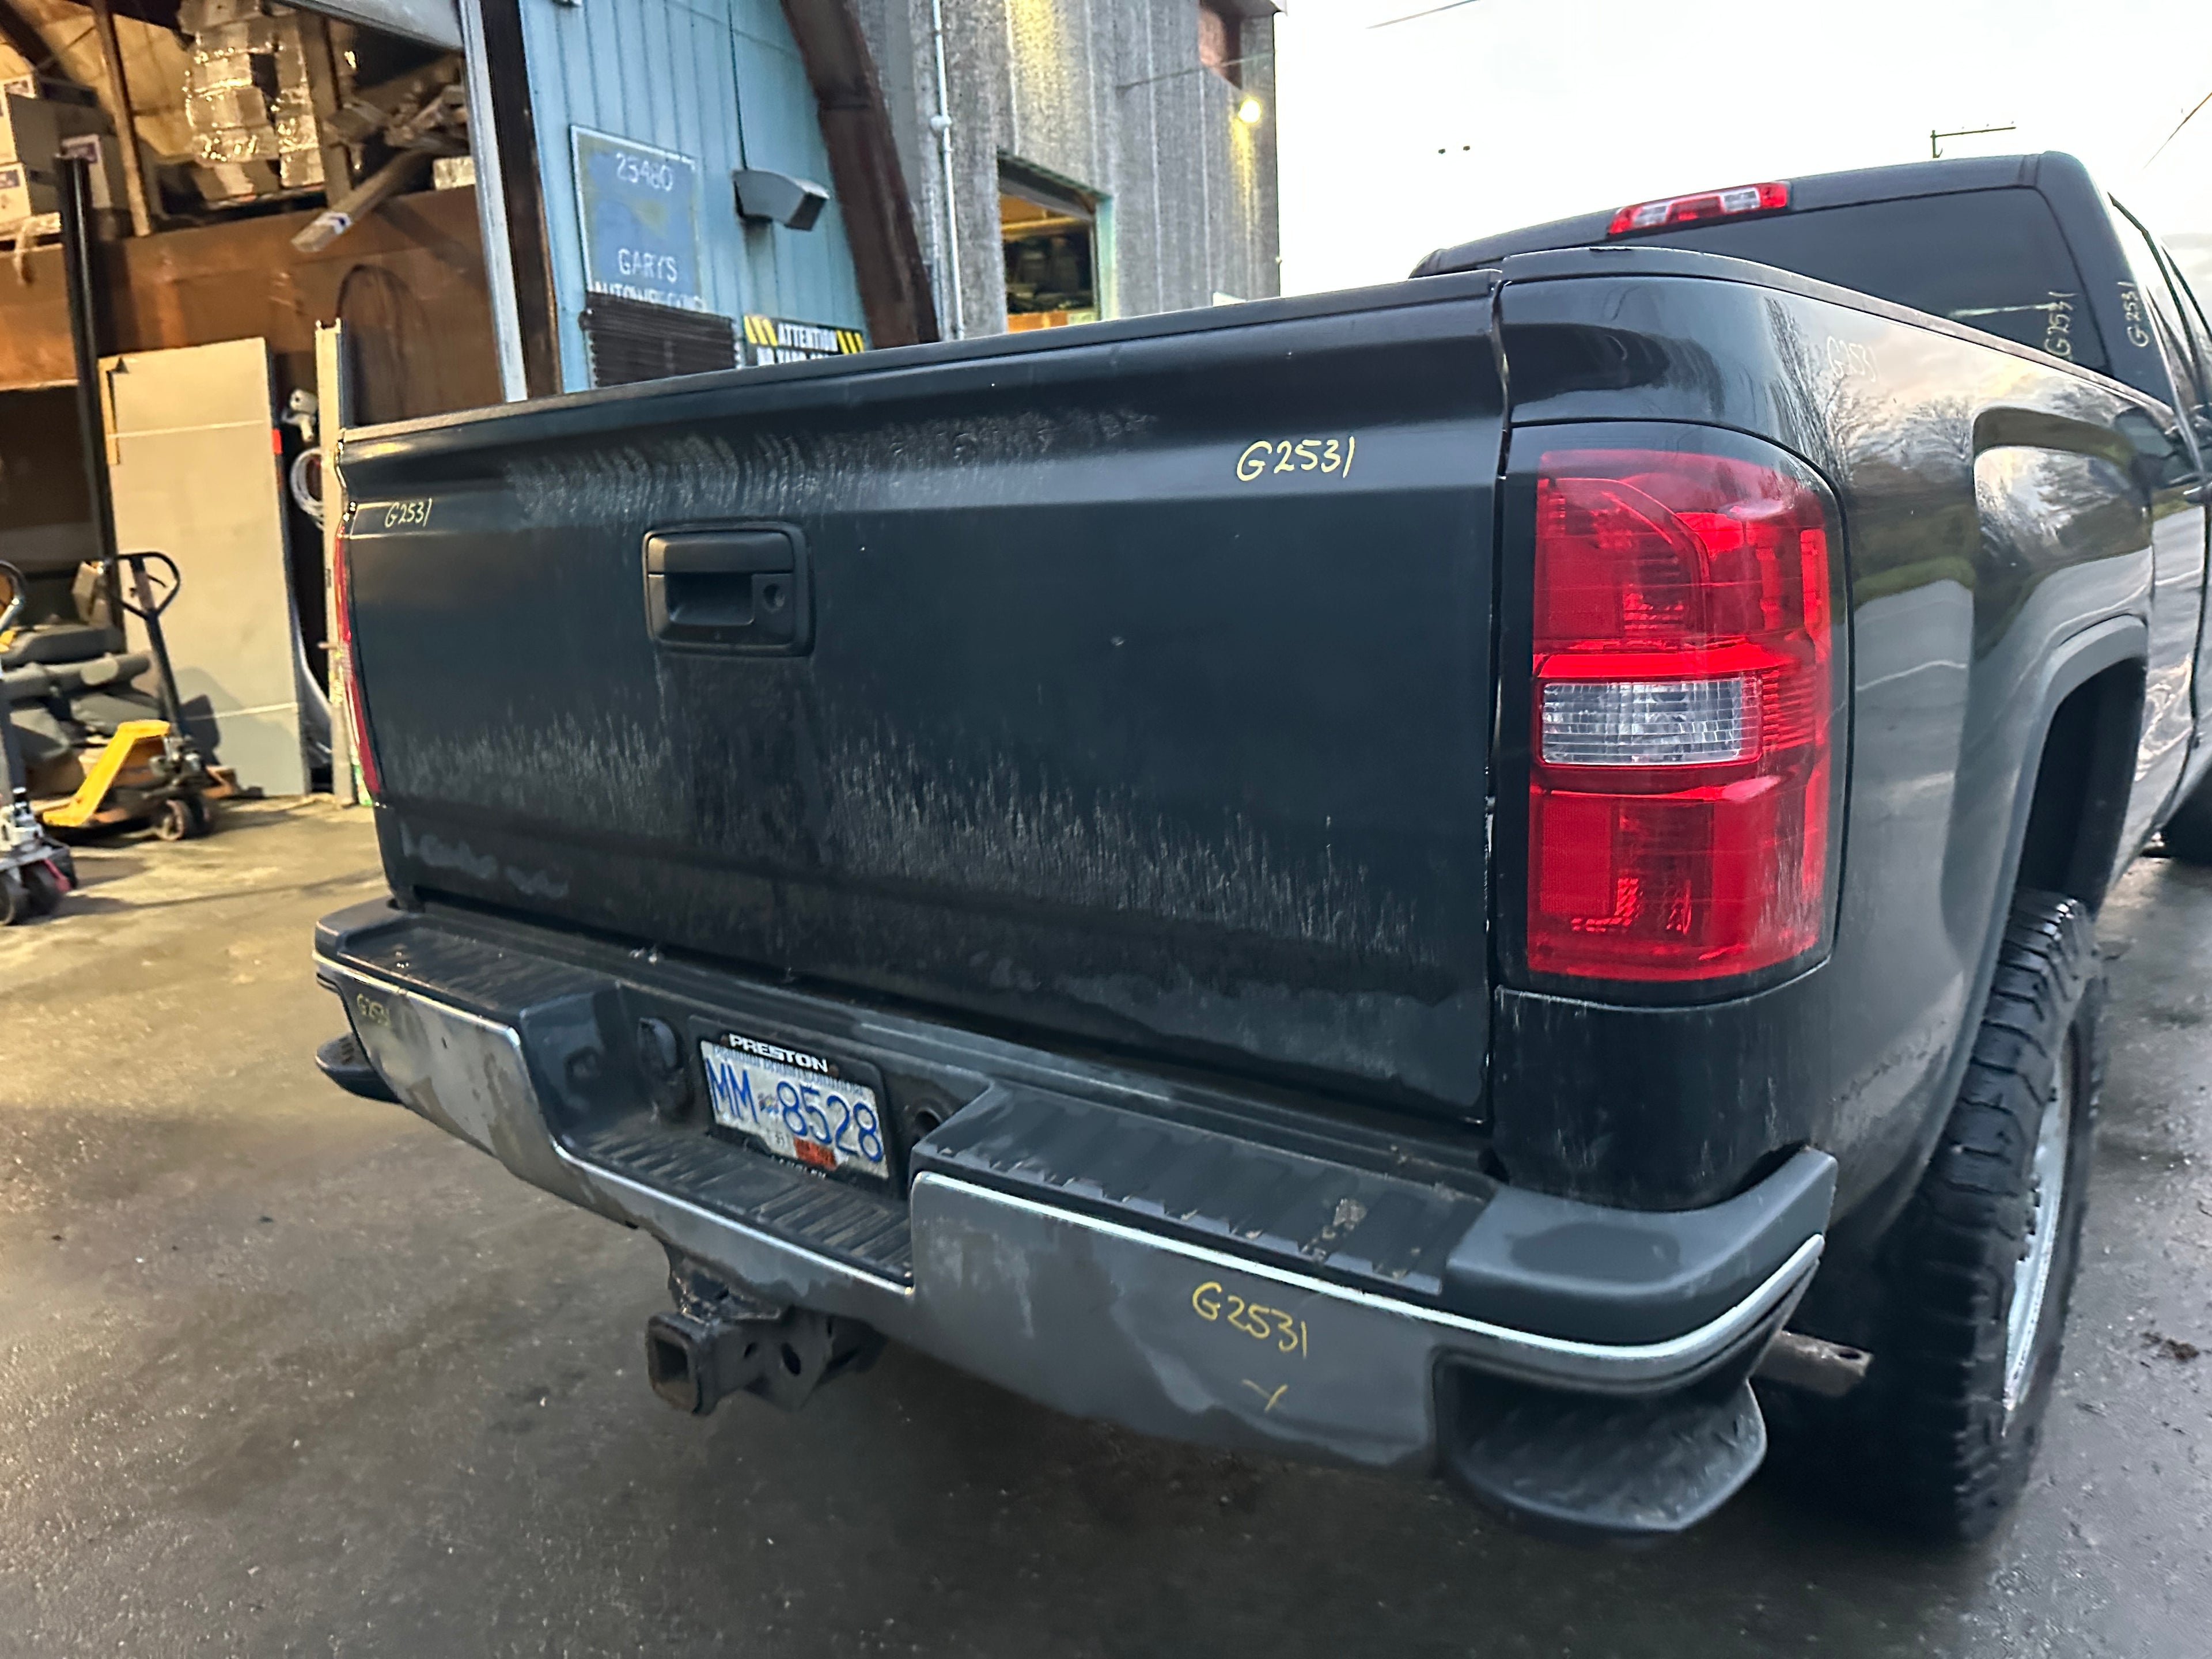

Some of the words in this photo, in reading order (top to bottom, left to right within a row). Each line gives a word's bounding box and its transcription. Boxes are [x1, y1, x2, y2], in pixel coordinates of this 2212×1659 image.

[778, 323, 839, 351] ATTENTION
[2044, 291, 2078, 357] G2531
[2117, 281, 2150, 347] G2531
[1237, 436, 1355, 482] G2531
[384, 498, 432, 528] G2531
[729, 1033, 828, 1073] PRESTON
[704, 1058, 759, 1124] MM
[777, 1081, 884, 1163] 8528
[1192, 1281, 1307, 1358] G2531
